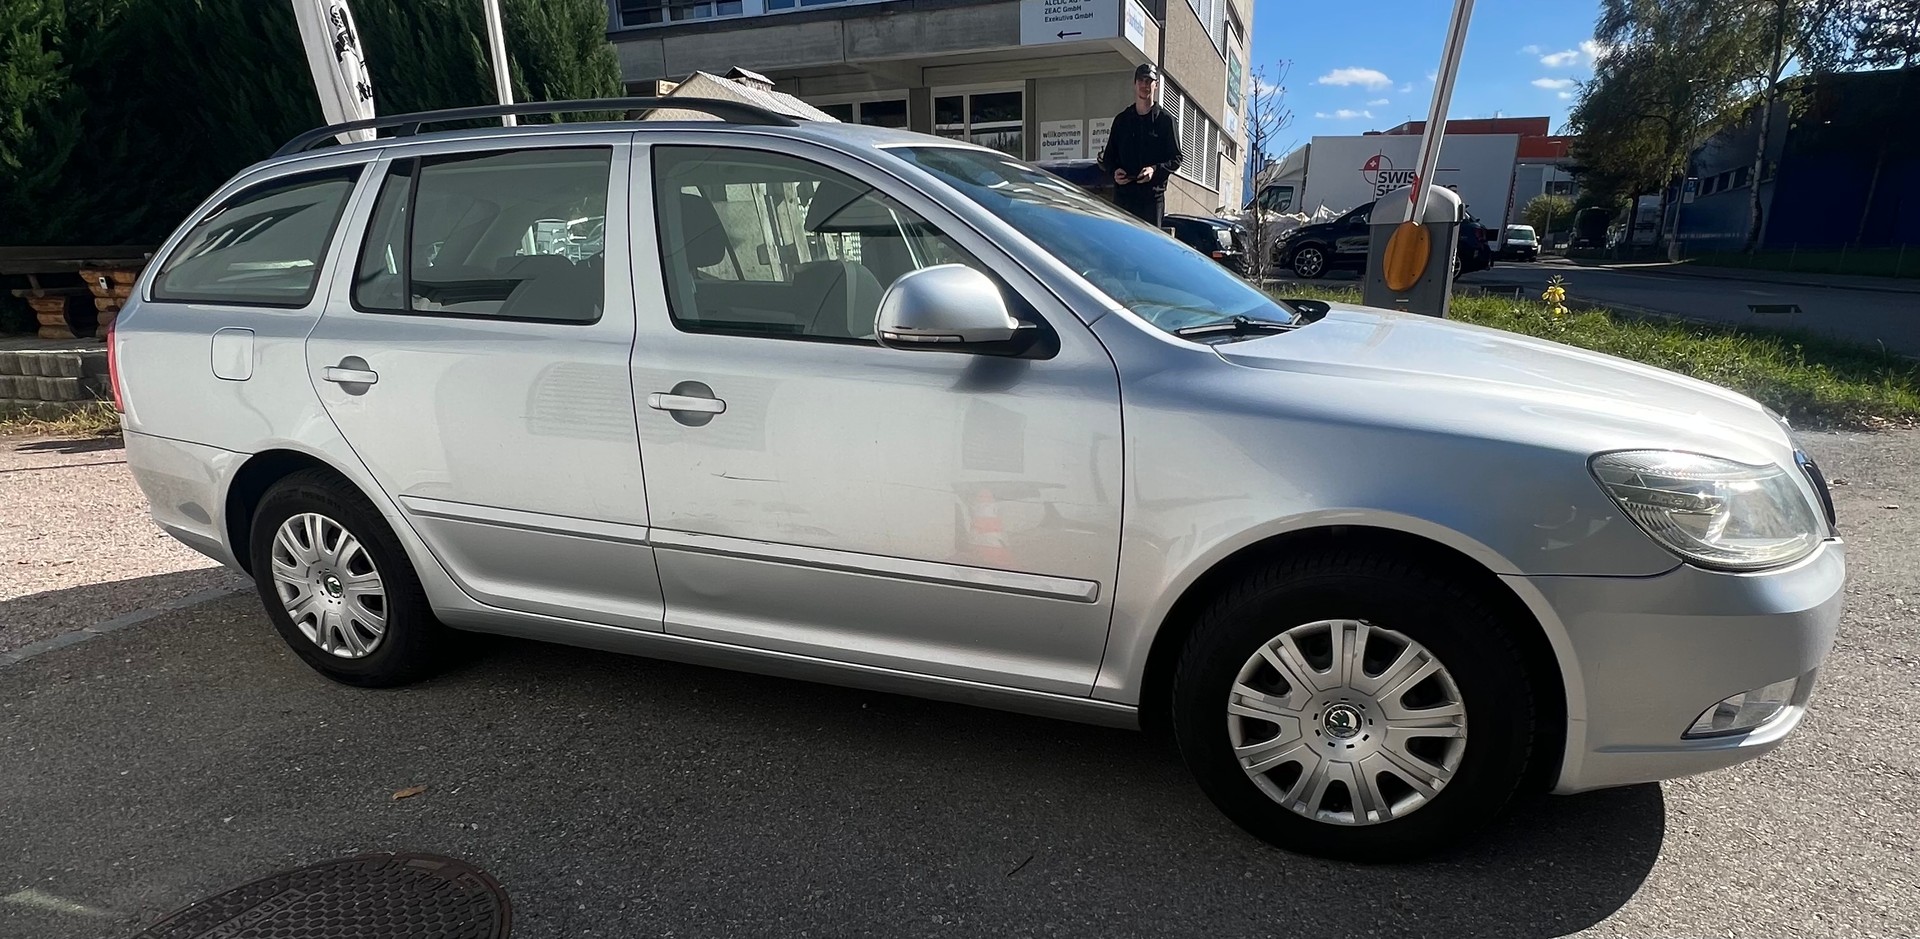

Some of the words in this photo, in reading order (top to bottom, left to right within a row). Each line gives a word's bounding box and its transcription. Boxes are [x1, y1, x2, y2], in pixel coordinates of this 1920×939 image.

[1075, 12, 1094, 20] GmbH
[1043, 130, 1081, 138] willkommen
[1377, 171, 1415, 184] SWIS
